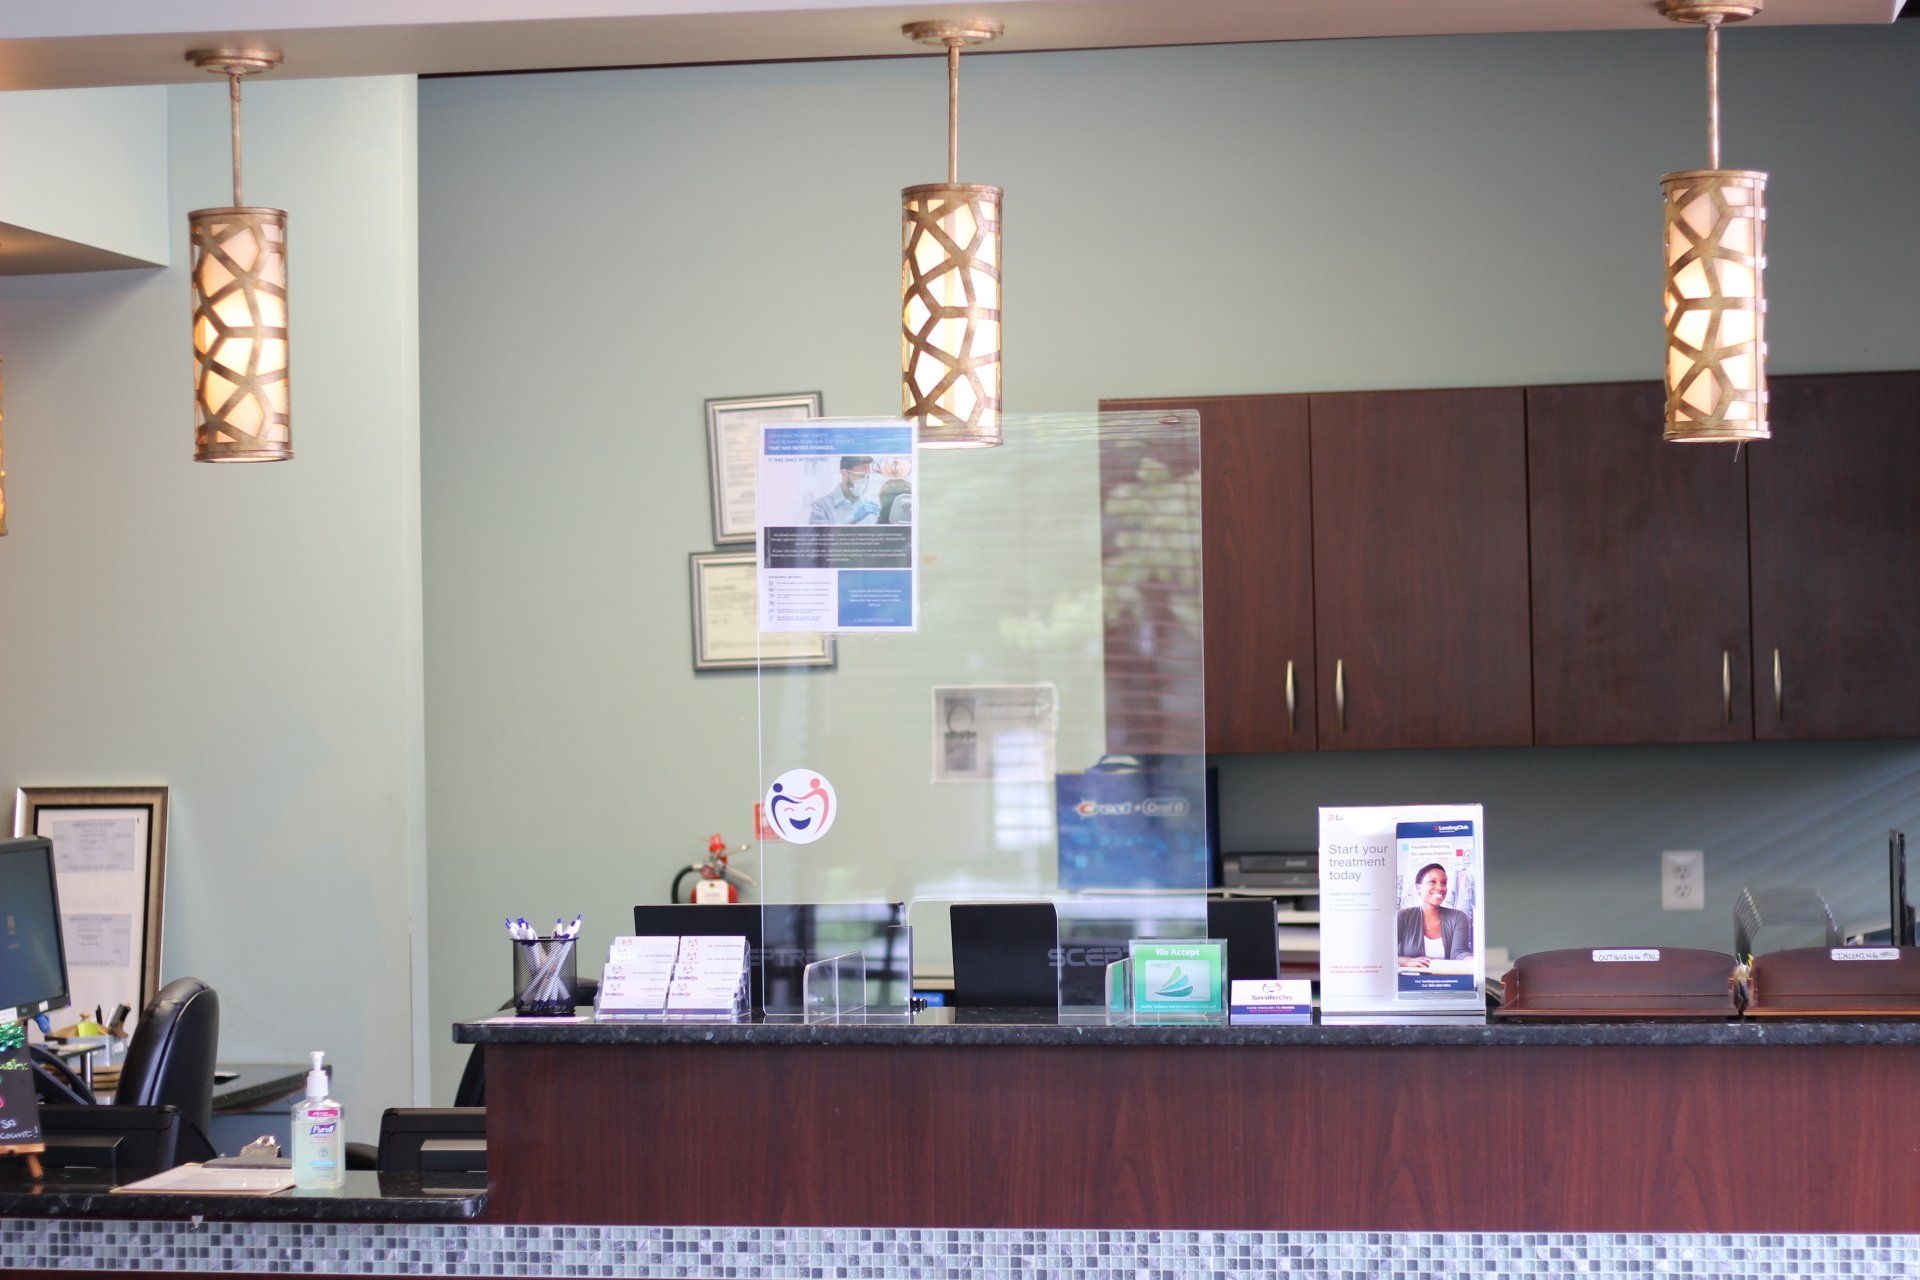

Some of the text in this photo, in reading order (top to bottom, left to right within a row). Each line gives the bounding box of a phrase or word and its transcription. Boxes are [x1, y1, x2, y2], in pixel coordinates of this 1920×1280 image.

[1329, 844, 1389, 855] Start your
[1329, 857, 1386, 867] treatment
[1330, 870, 1361, 882] today
[1048, 948, 1129, 966] SCEP
[1155, 948, 1200, 957] We Accept
[313, 1125, 334, 1133] Purell
